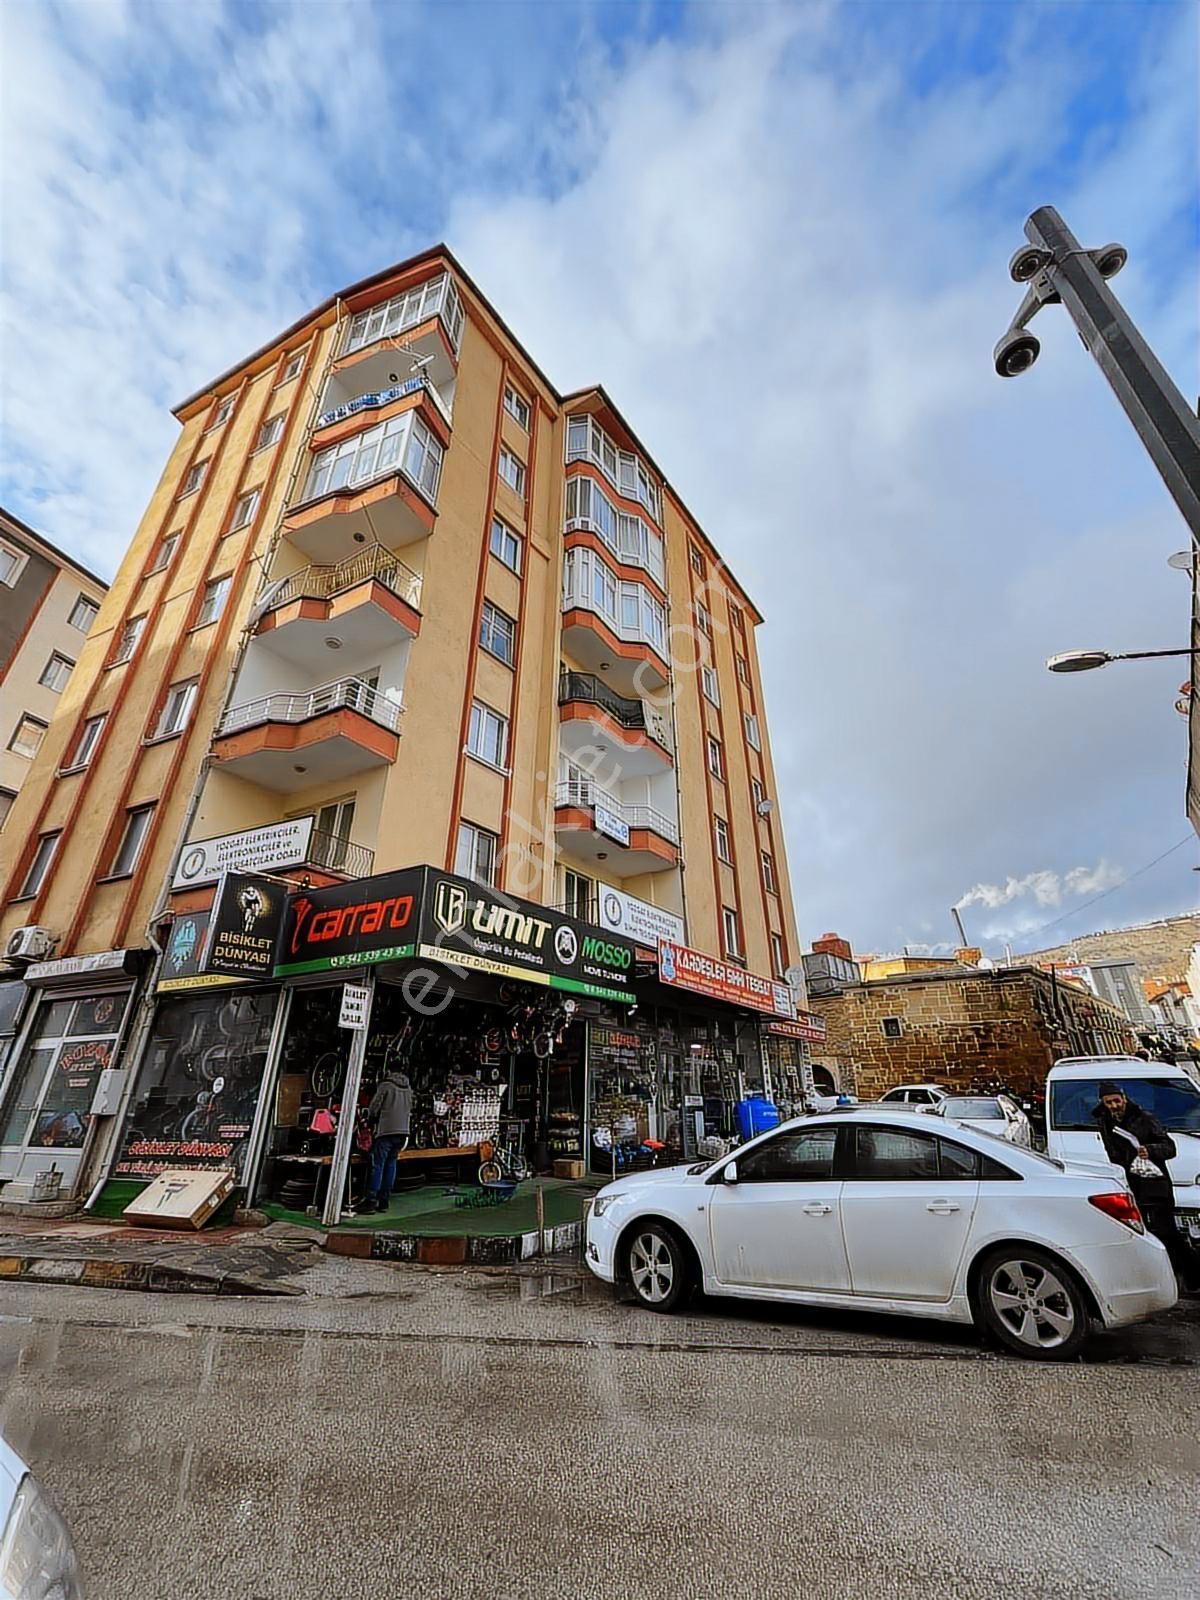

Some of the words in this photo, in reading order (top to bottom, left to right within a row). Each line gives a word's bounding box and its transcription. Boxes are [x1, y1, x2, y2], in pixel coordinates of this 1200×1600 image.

[307, 895, 414, 942] carraro
[220, 930, 273, 950] BİSİKLET
[214, 945, 271, 964] DÜNYASI
[581, 935, 631, 970] MOSSO
[473, 957, 511, 974] DÜNYASI
